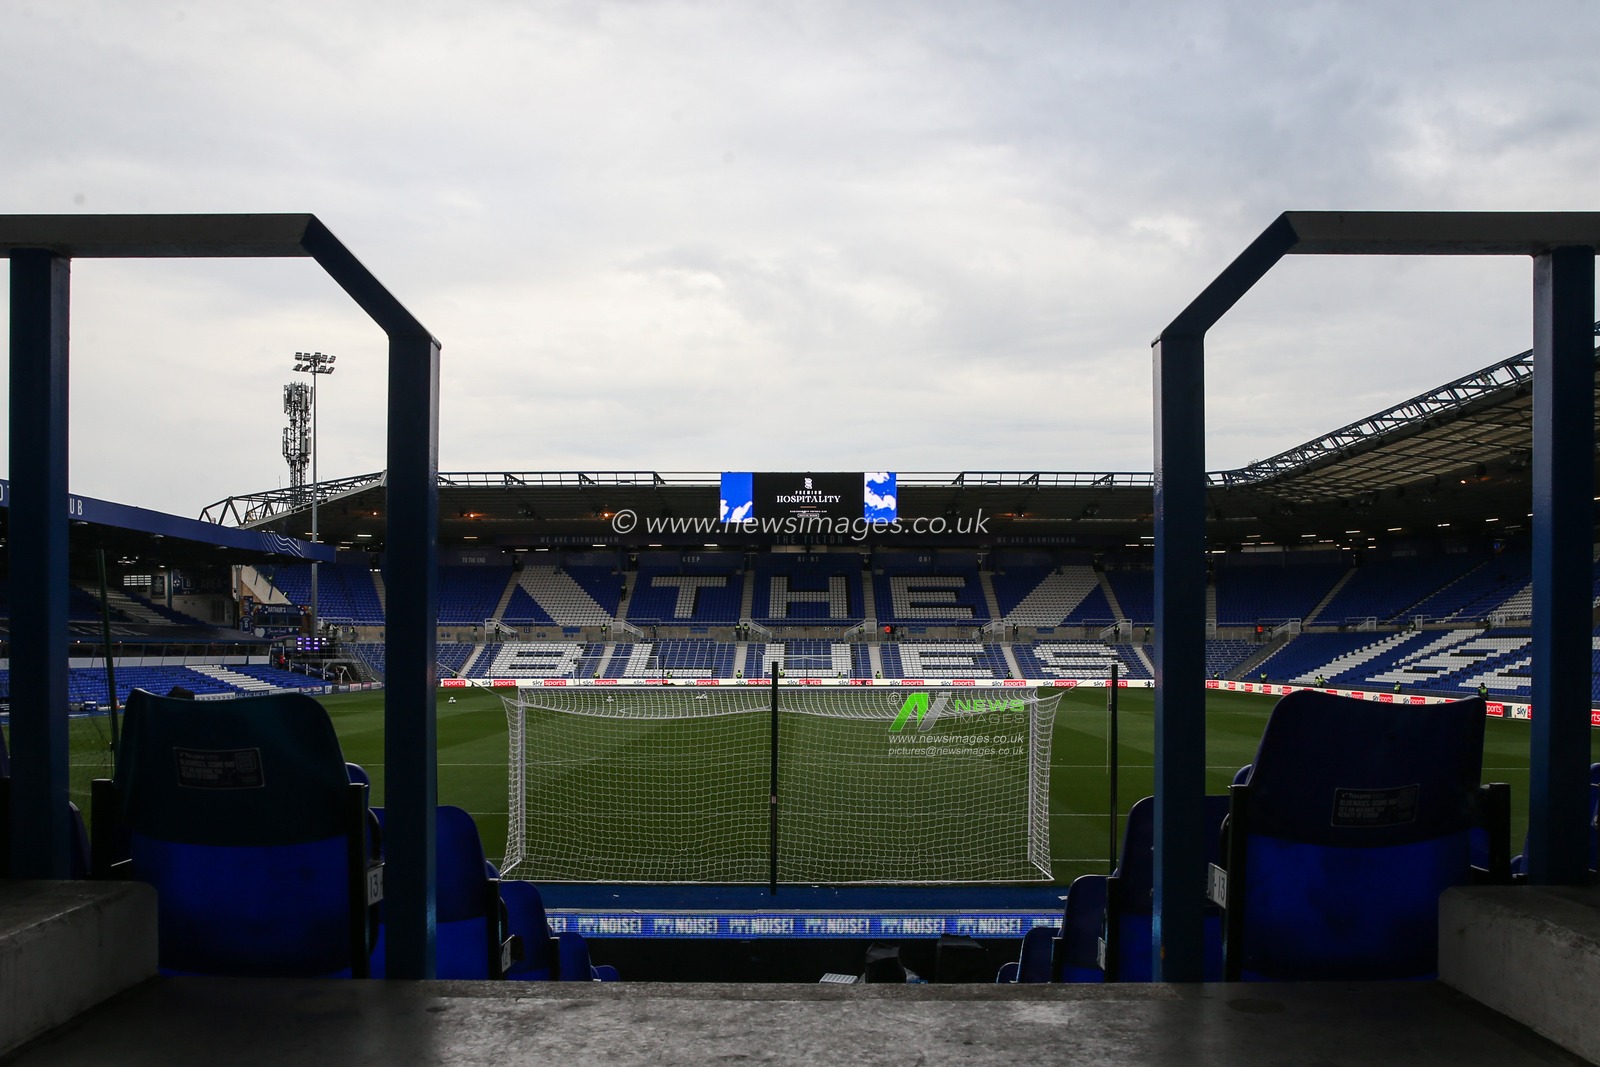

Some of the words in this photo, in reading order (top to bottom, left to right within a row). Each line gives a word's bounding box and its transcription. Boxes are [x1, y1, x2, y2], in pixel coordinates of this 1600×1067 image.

[69, 497, 83, 515] UB
[776, 495, 841, 503] HOSPITALITY
[776, 535, 795, 544] THE
[804, 535, 843, 544] TILTON
[651, 576, 974, 619] THE
[484, 643, 1130, 679] BLUES
[444, 680, 465, 688] sports
[494, 680, 516, 688] sports
[533, 680, 543, 688] sky
[545, 680, 566, 688] sports
[1055, 680, 1077, 688] sports
[1487, 703, 1503, 714] ports
[1516, 706, 1527, 717] sky
[370, 874, 379, 898] 13
[1217, 875, 1226, 901] 13
[600, 917, 641, 934] NOISE!
[675, 917, 717, 934] NOISE!
[752, 917, 794, 934] NOISE!
[827, 917, 870, 934] NOISE!
[902, 917, 945, 934] NOISE!
[978, 917, 1021, 934] NOISE!
